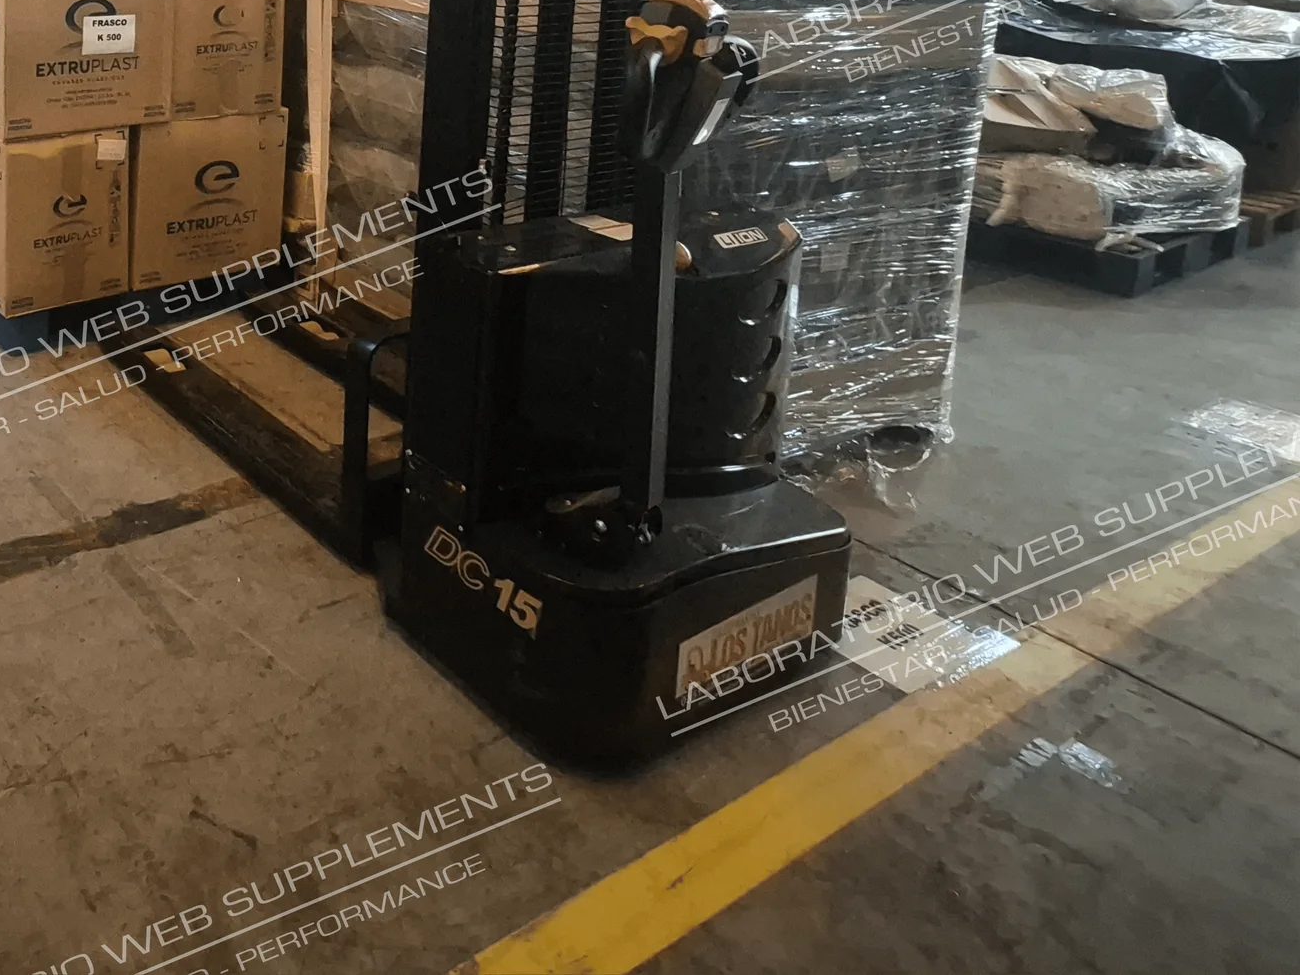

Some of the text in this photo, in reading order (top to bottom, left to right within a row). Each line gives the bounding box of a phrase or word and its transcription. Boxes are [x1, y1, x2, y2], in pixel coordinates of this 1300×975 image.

[92, 18, 127, 28] FRASCO
[97, 33, 122, 42] K 500
[196, 40, 260, 56] EXTRUPLAST
[35, 55, 140, 77] EXTRUPLAST
[166, 209, 258, 236] EXTRUPLAST
[33, 226, 104, 250] EXTRUPLAST
[424, 526, 543, 630] DC 15
